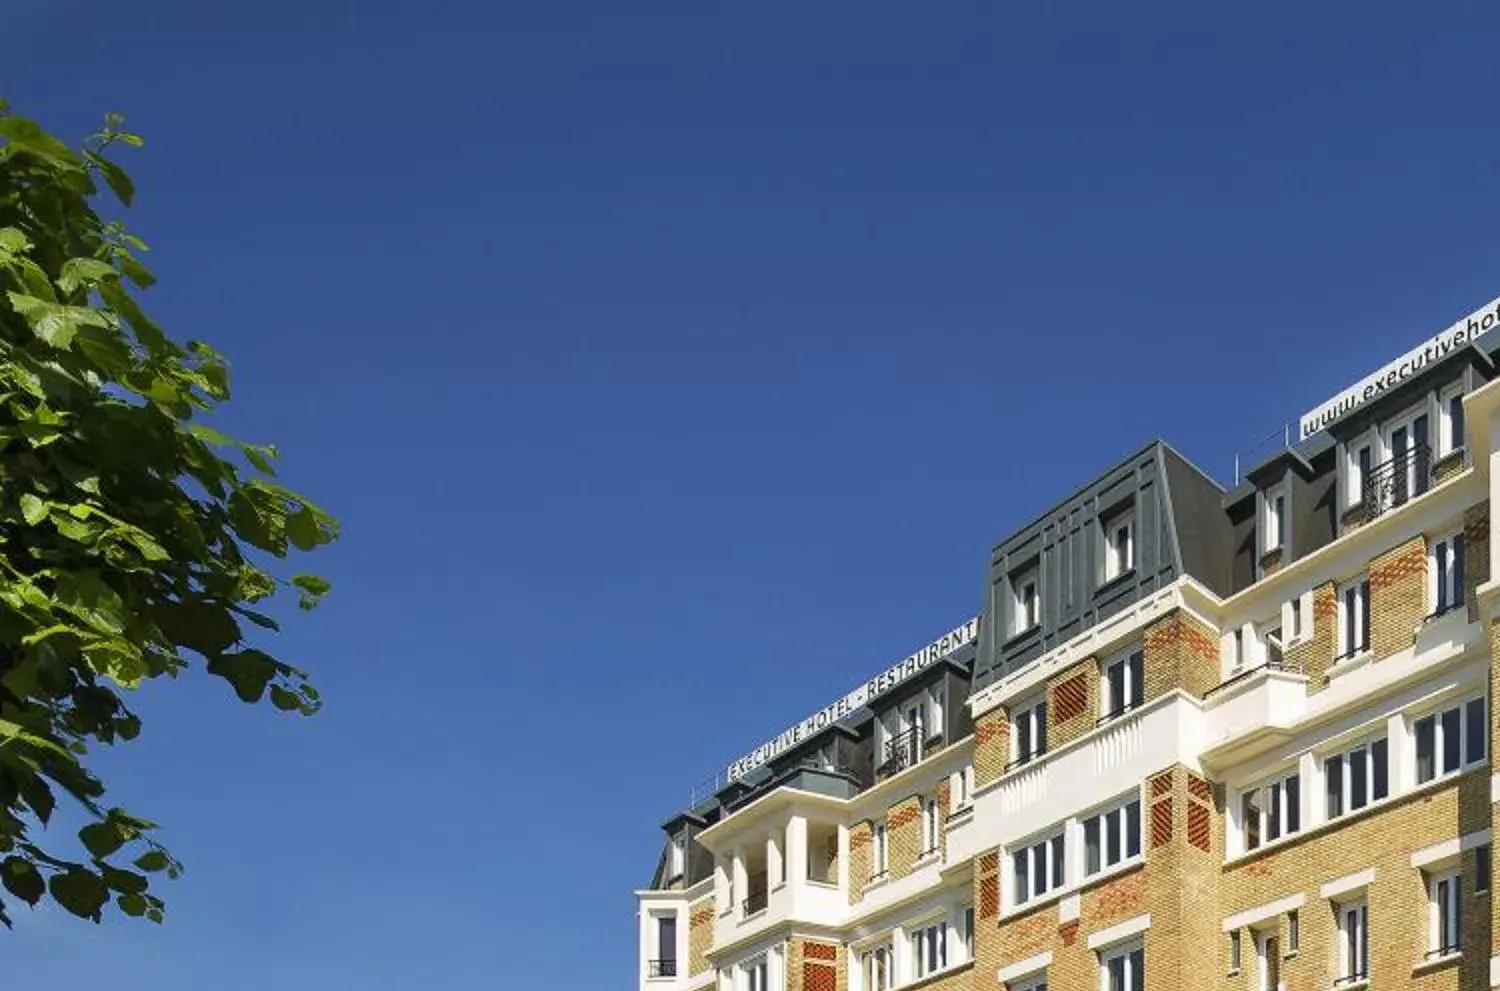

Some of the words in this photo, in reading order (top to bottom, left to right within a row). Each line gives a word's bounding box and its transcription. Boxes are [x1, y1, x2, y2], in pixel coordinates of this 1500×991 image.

[730, 724, 801, 782] EXECUTIVE
[807, 697, 852, 732] HOTEL
[867, 621, 974, 700] RESTAURANT
